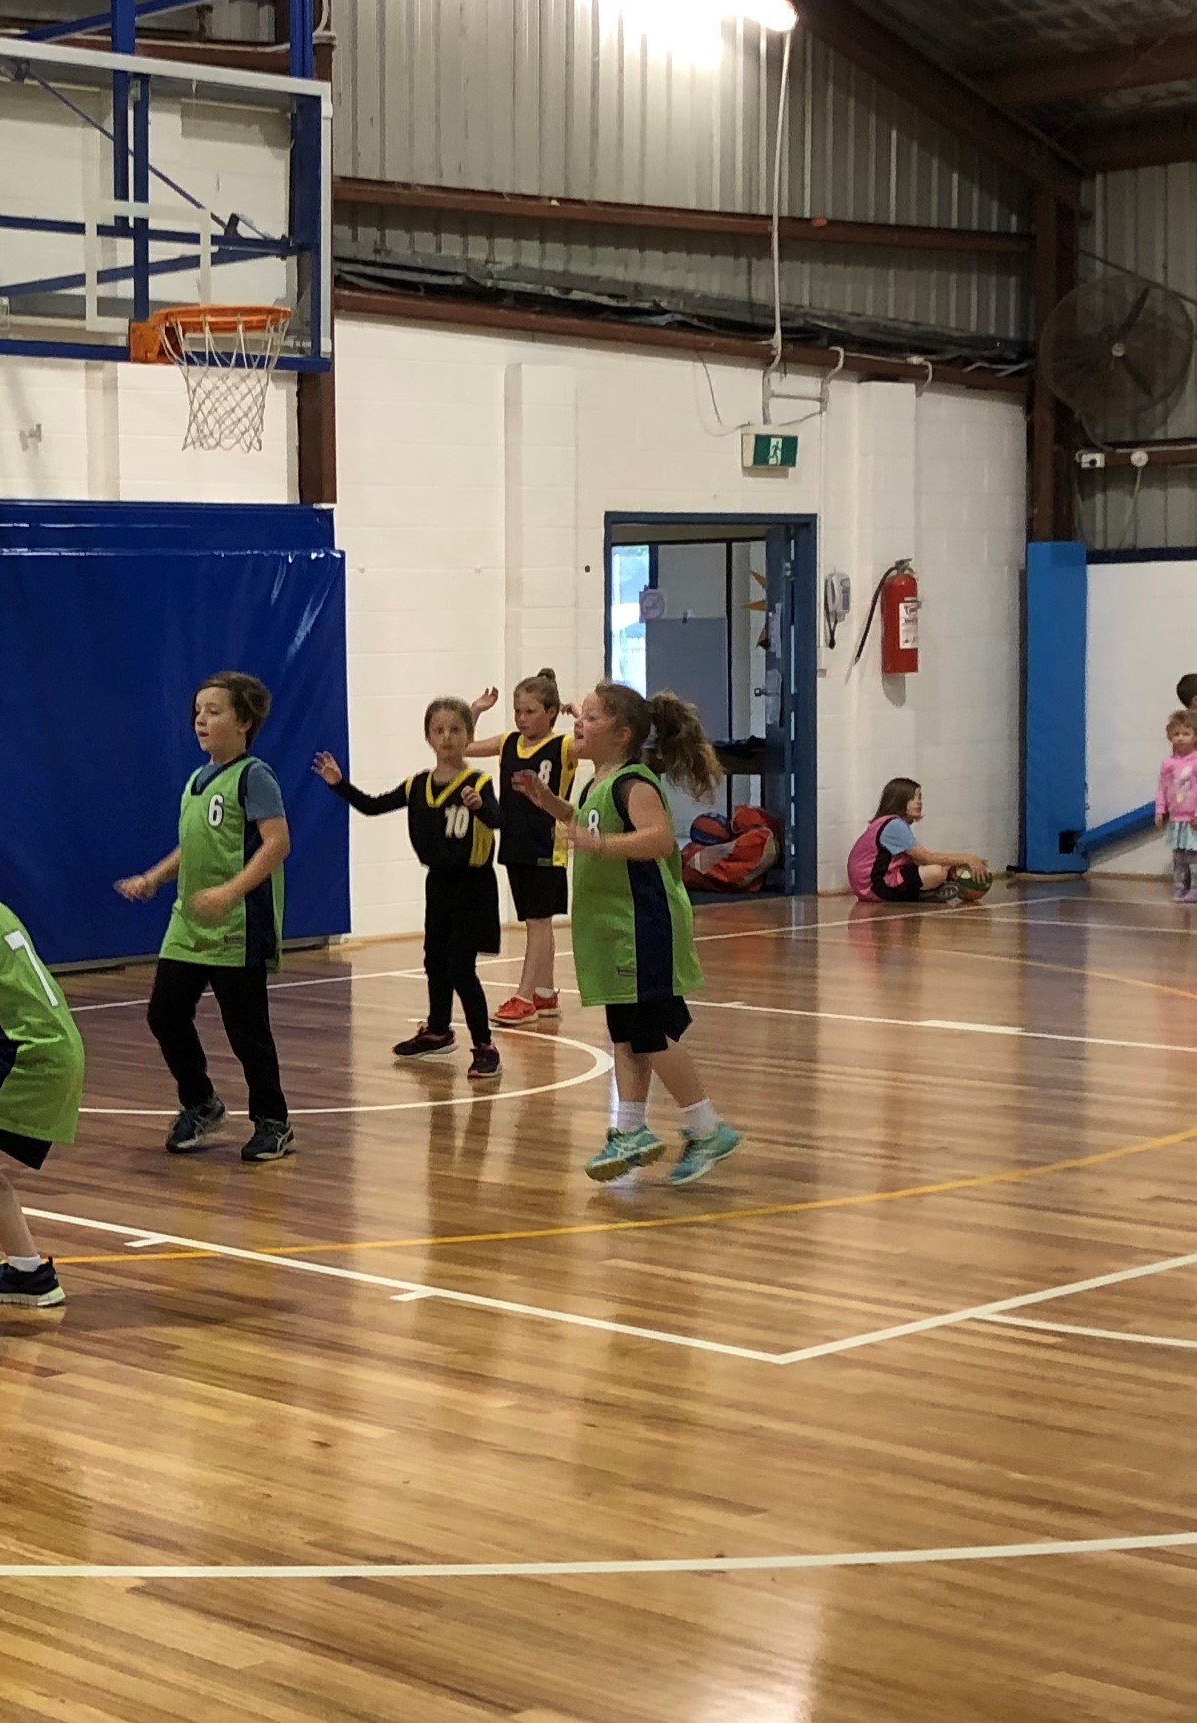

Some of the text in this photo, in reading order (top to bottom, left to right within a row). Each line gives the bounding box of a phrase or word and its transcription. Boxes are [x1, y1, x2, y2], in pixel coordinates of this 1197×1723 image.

[539, 758, 552, 786] 8
[208, 793, 224, 827] 6
[444, 804, 470, 840] 10
[588, 809, 601, 840] 8
[3, 930, 59, 1007] 7
